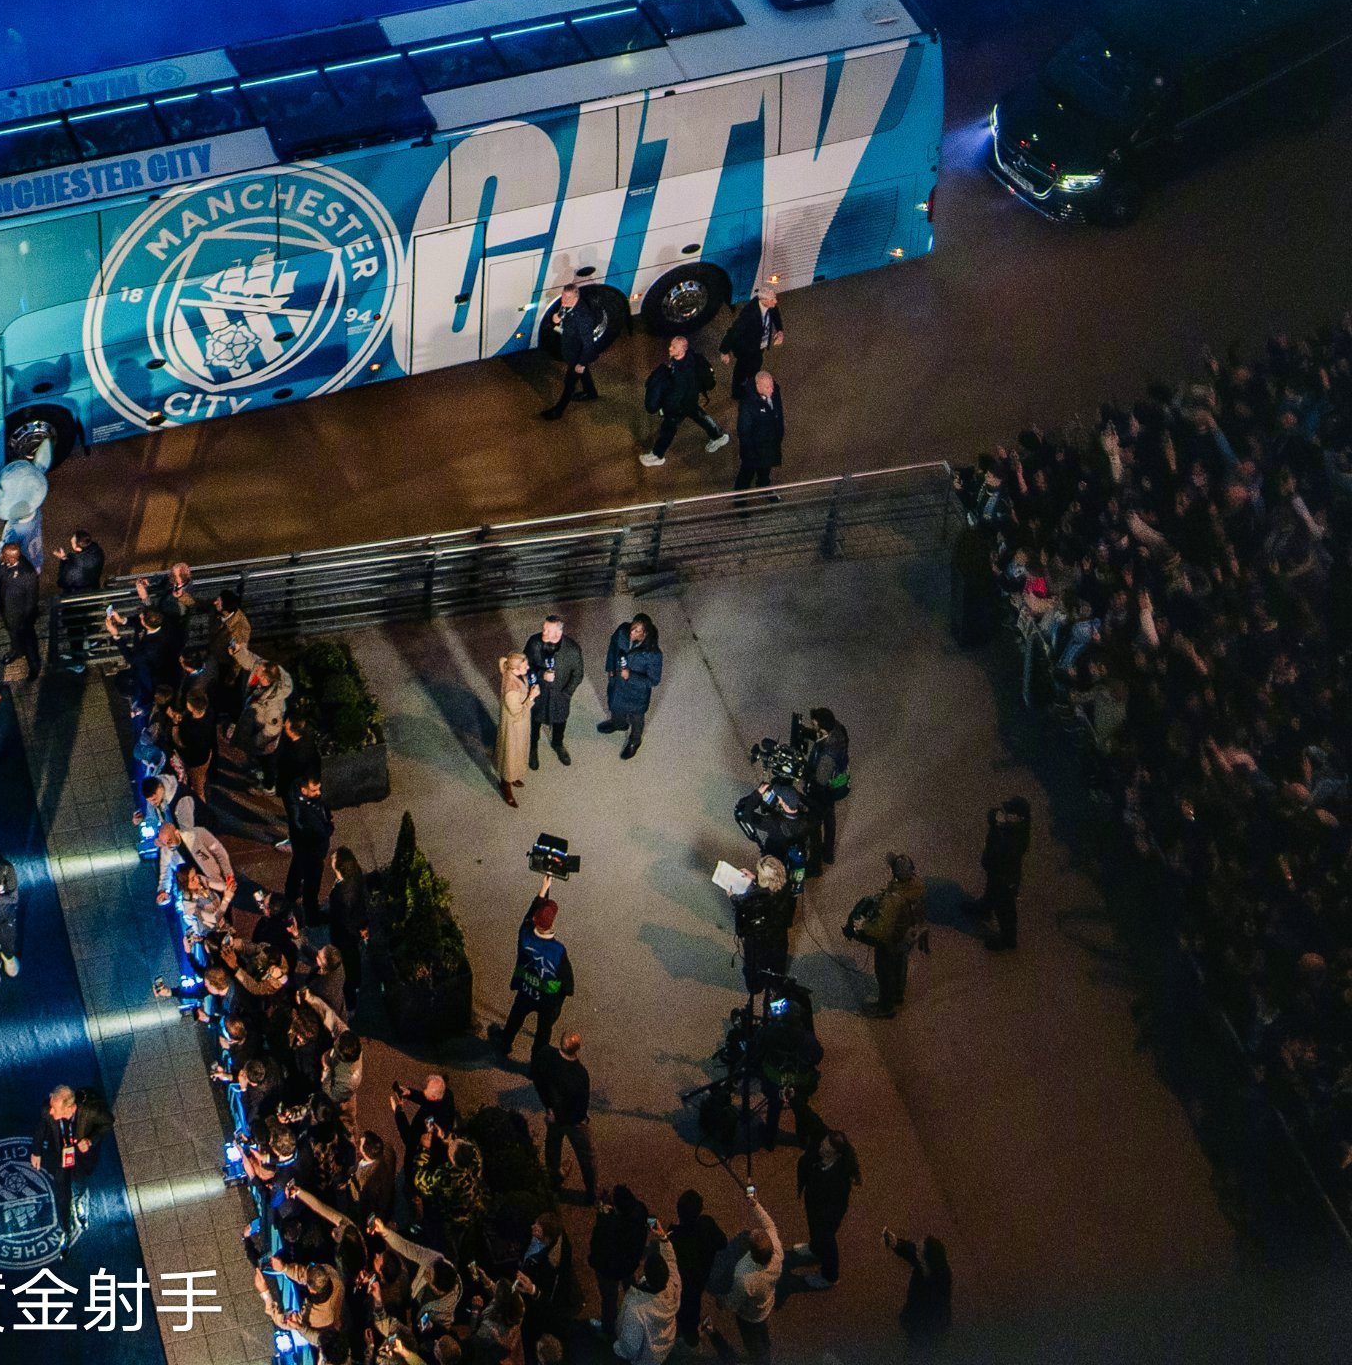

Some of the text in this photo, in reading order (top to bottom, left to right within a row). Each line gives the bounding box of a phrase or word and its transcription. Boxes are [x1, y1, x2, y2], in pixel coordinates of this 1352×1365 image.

[148, 143, 212, 183] CITY
[391, 38, 909, 375] CITY
[145, 183, 380, 281] MANCHESTER
[119, 286, 144, 303] 18
[343, 307, 371, 324] 94
[163, 391, 253, 419] CITY
